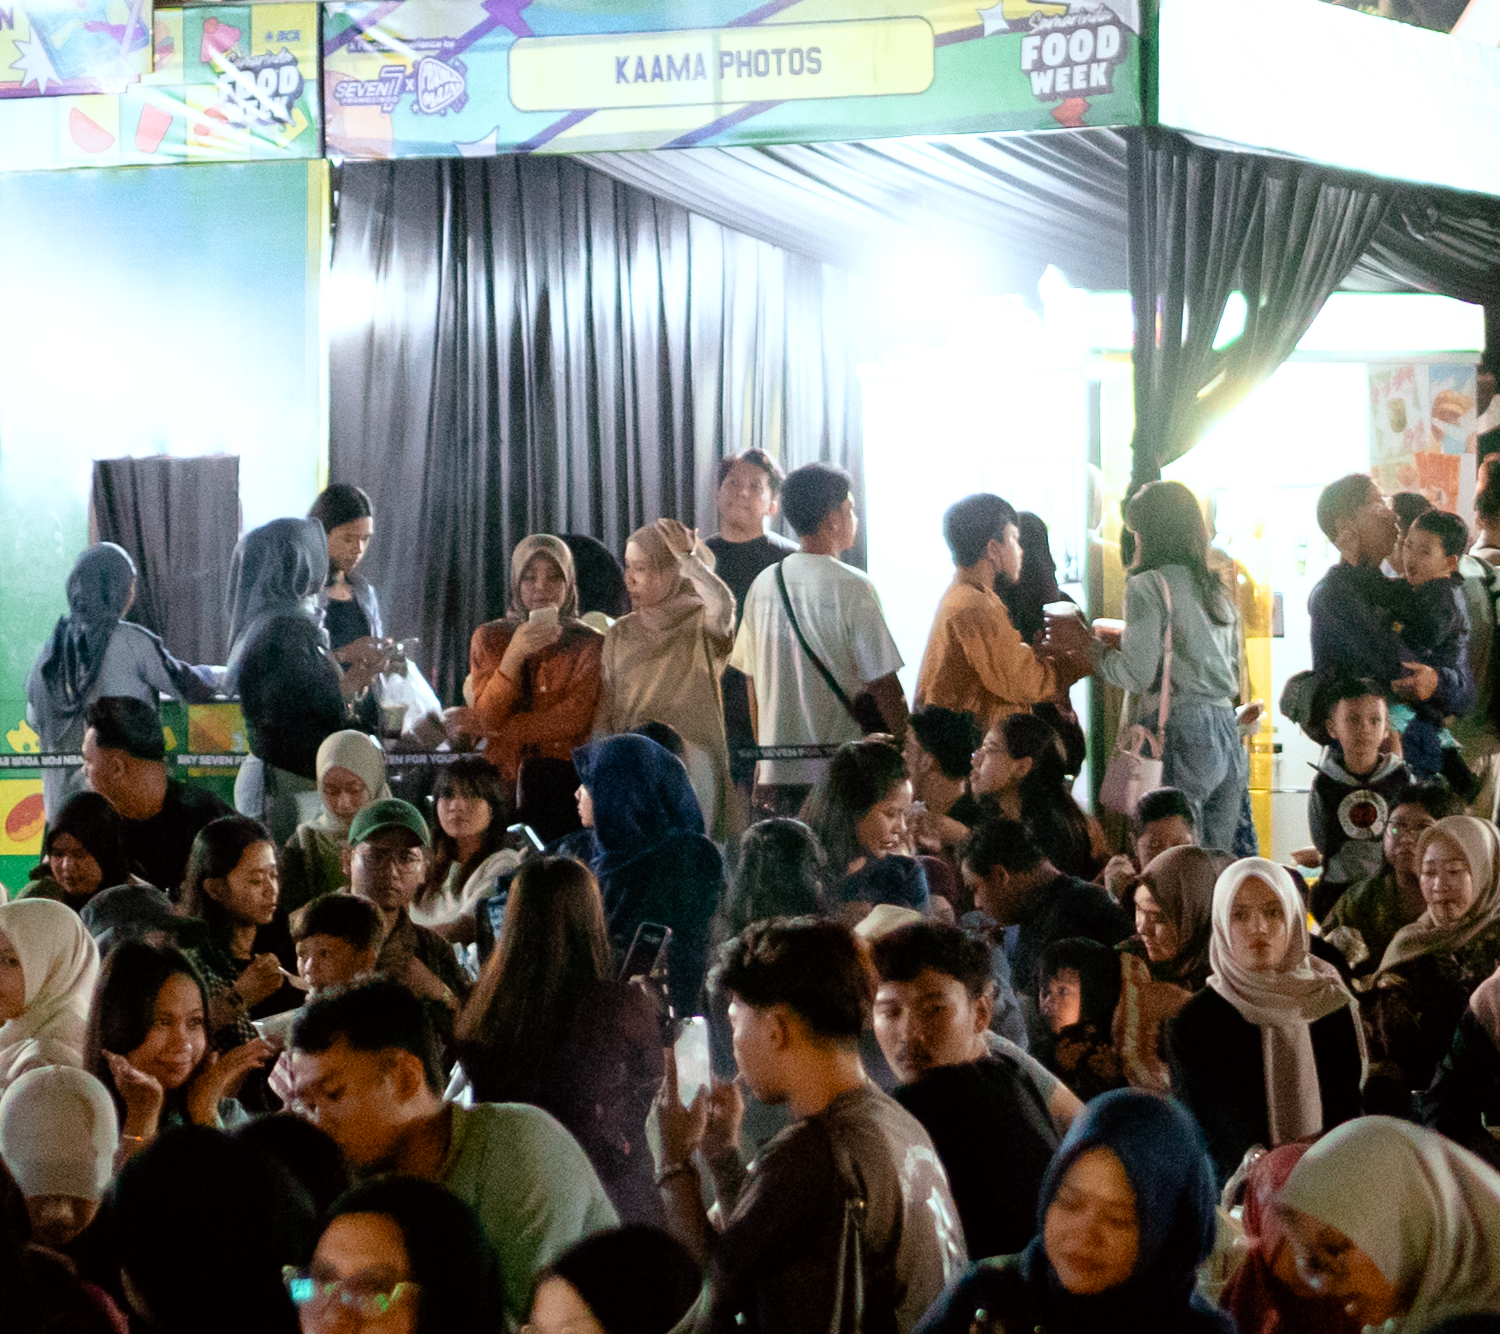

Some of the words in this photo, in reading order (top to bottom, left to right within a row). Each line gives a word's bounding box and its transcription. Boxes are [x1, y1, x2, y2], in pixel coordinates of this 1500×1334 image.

[615, 53, 707, 84] KAAMA
[717, 46, 822, 79] PHOTOS
[1021, 25, 1120, 70] FOOD
[1030, 62, 1107, 96] WEEK
